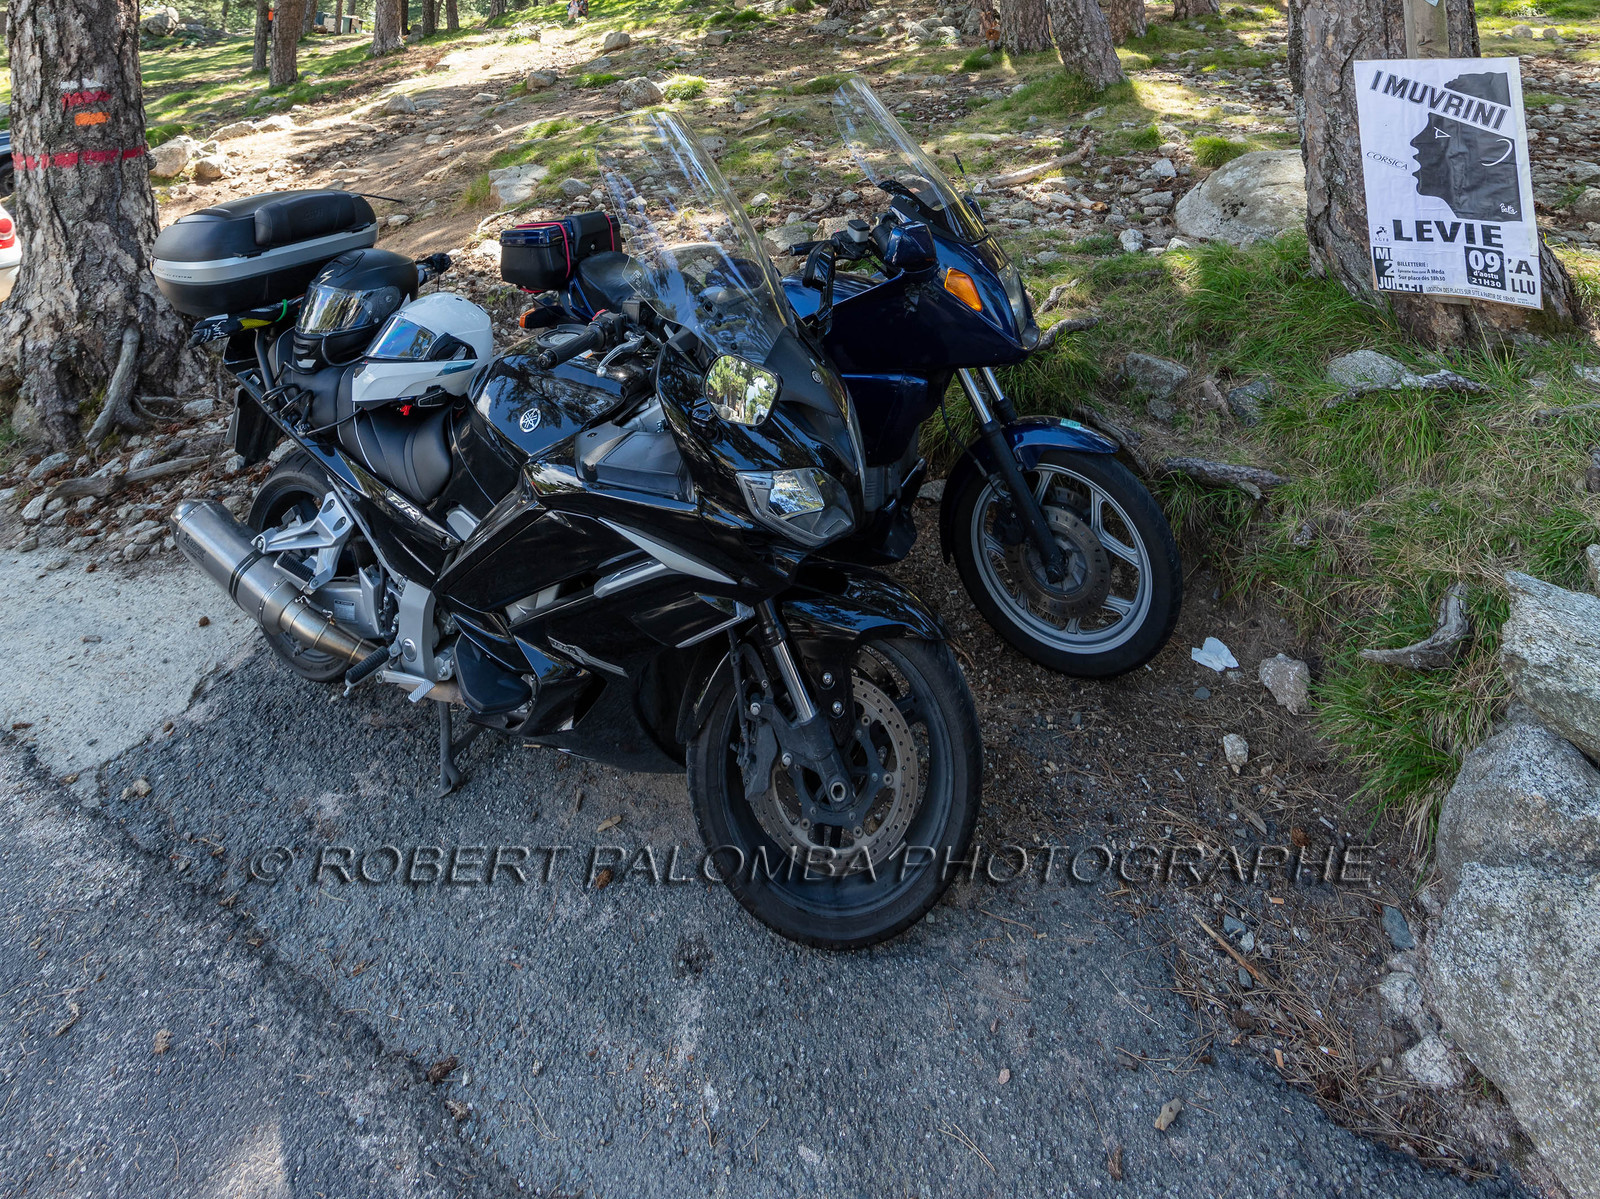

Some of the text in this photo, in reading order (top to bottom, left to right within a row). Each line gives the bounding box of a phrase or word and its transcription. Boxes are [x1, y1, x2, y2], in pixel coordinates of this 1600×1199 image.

[1370, 69, 1509, 132] I MUVRINI
[1366, 150, 1409, 171] CORSICA
[1393, 219, 1503, 248] LEVIE
[1469, 250, 1501, 272] 09
[1472, 277, 1501, 287] 21H30
